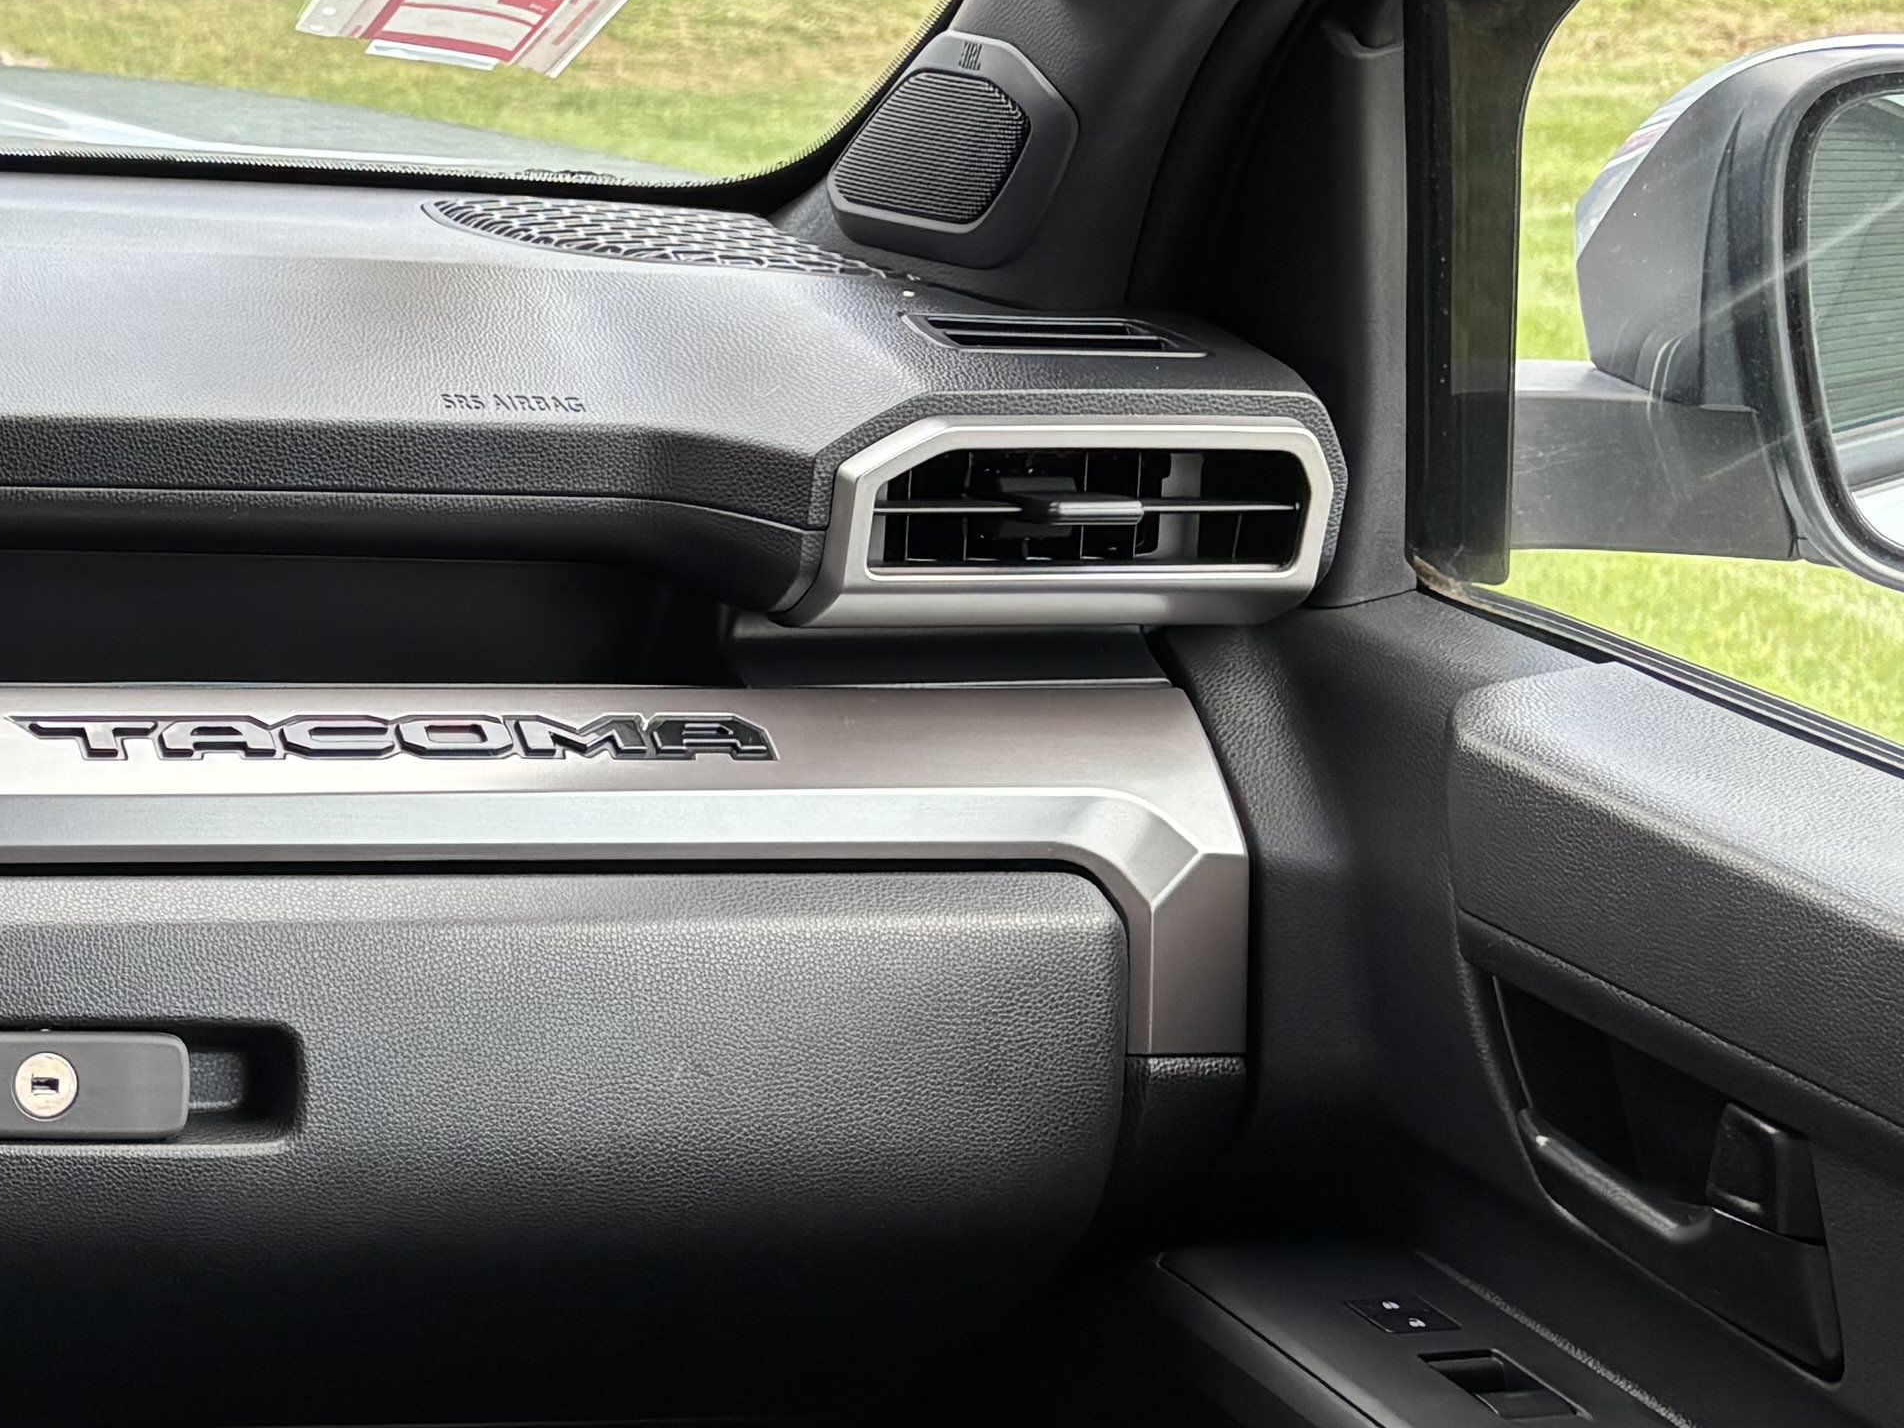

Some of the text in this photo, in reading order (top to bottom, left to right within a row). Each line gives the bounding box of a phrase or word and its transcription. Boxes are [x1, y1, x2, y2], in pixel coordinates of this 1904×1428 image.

[440, 393, 587, 413] SRS AIRBAG
[3, 711, 782, 764] TACOMA
